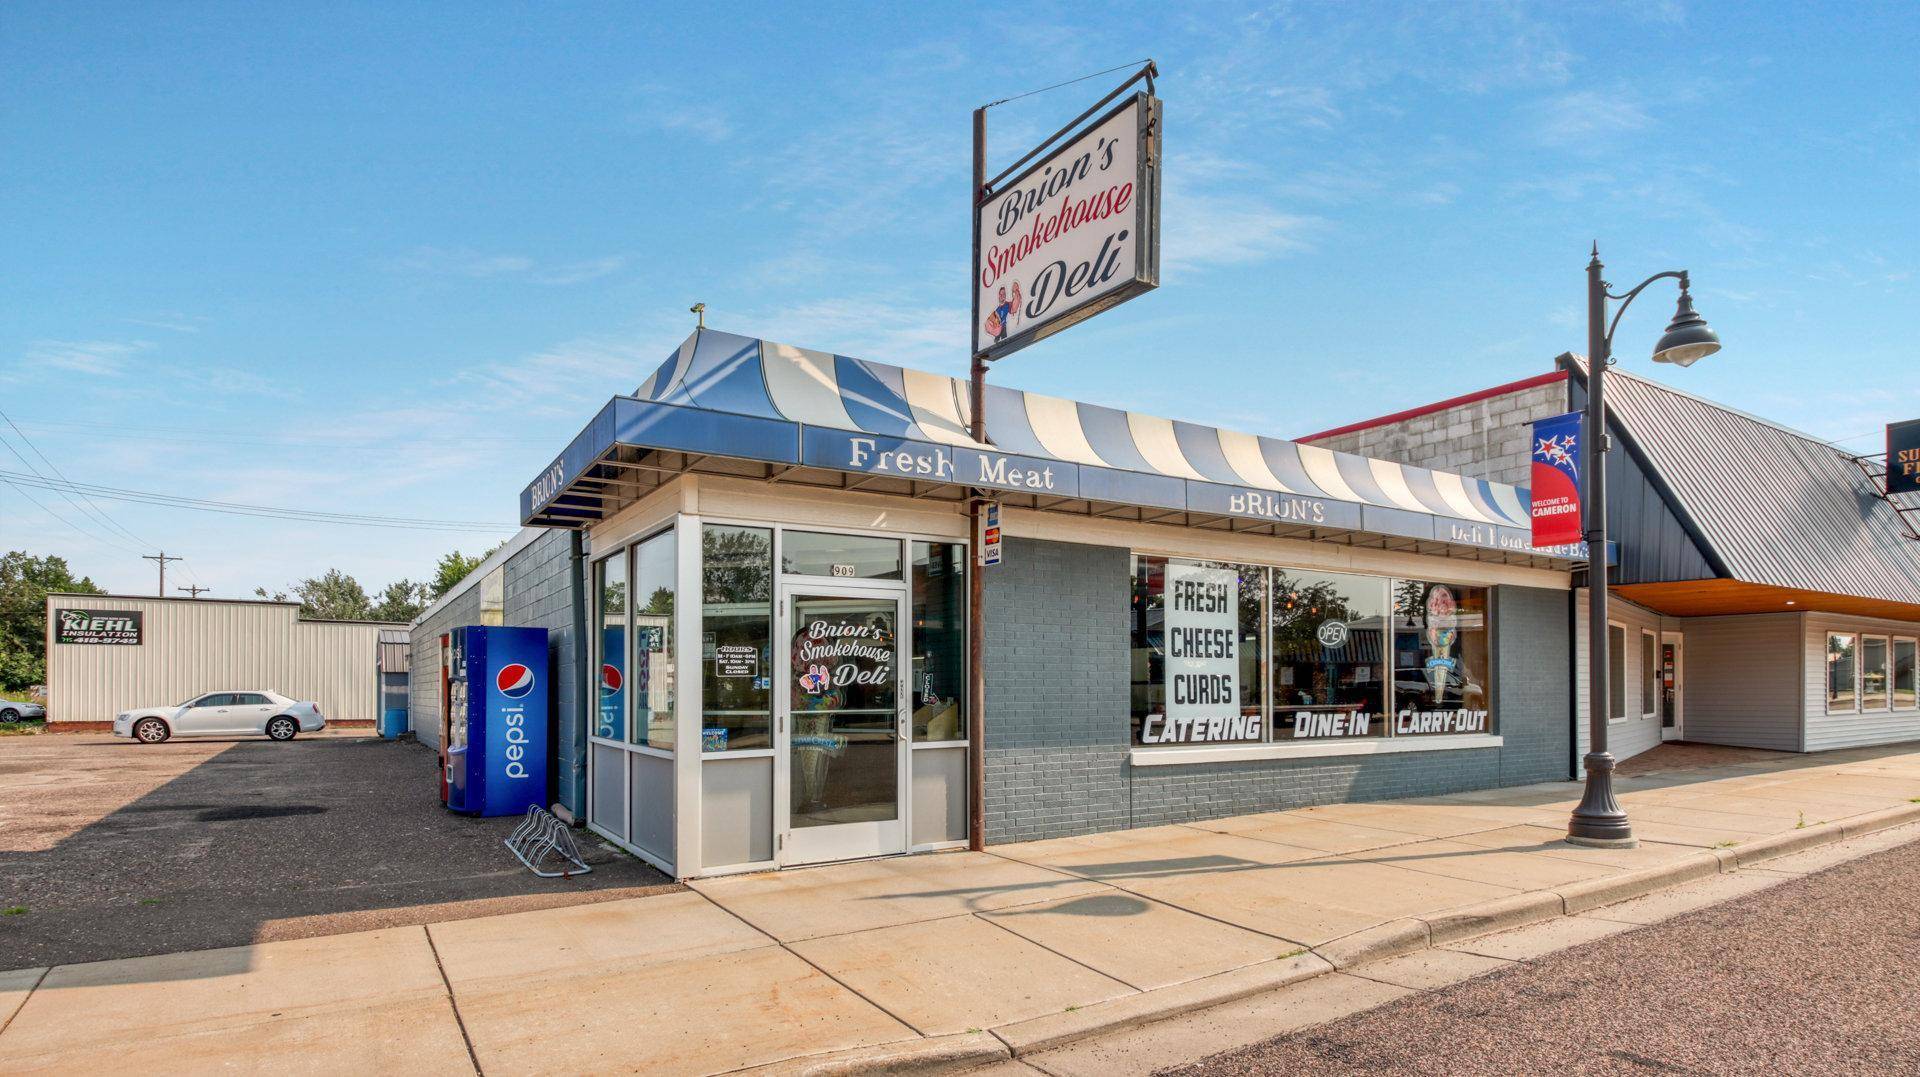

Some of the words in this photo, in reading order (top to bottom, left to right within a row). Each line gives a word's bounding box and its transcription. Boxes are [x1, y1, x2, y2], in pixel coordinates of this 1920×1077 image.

[996, 137, 1118, 236] Brion's
[982, 182, 1133, 288] Smokehouse
[1025, 229, 1129, 319] Deli
[850, 437, 954, 478] Fresh
[978, 454, 1054, 490] Meat
[531, 458, 564, 510] BRION'S
[1229, 491, 1325, 523] BRION'S
[1532, 497, 1560, 507] WELCOME
[1532, 503, 1577, 517] CAMERON
[986, 547, 999, 558] VISA
[834, 566, 854, 576] 909
[1174, 580, 1228, 613] FRESH
[63, 620, 138, 631] KIEHL
[808, 620, 883, 640] Brion's
[1318, 626, 1348, 641] OPEN
[800, 639, 890, 662] Smokehouse
[1171, 627, 1234, 659] CHEESE
[833, 664, 890, 686] Deli
[1174, 674, 1232, 705] CURDS
[1142, 714, 1261, 744] CATERING
[1294, 710, 1371, 738] DINE-IN
[1397, 708, 1488, 735] CARRY-OUT
[501, 707, 529, 779] pepsi
